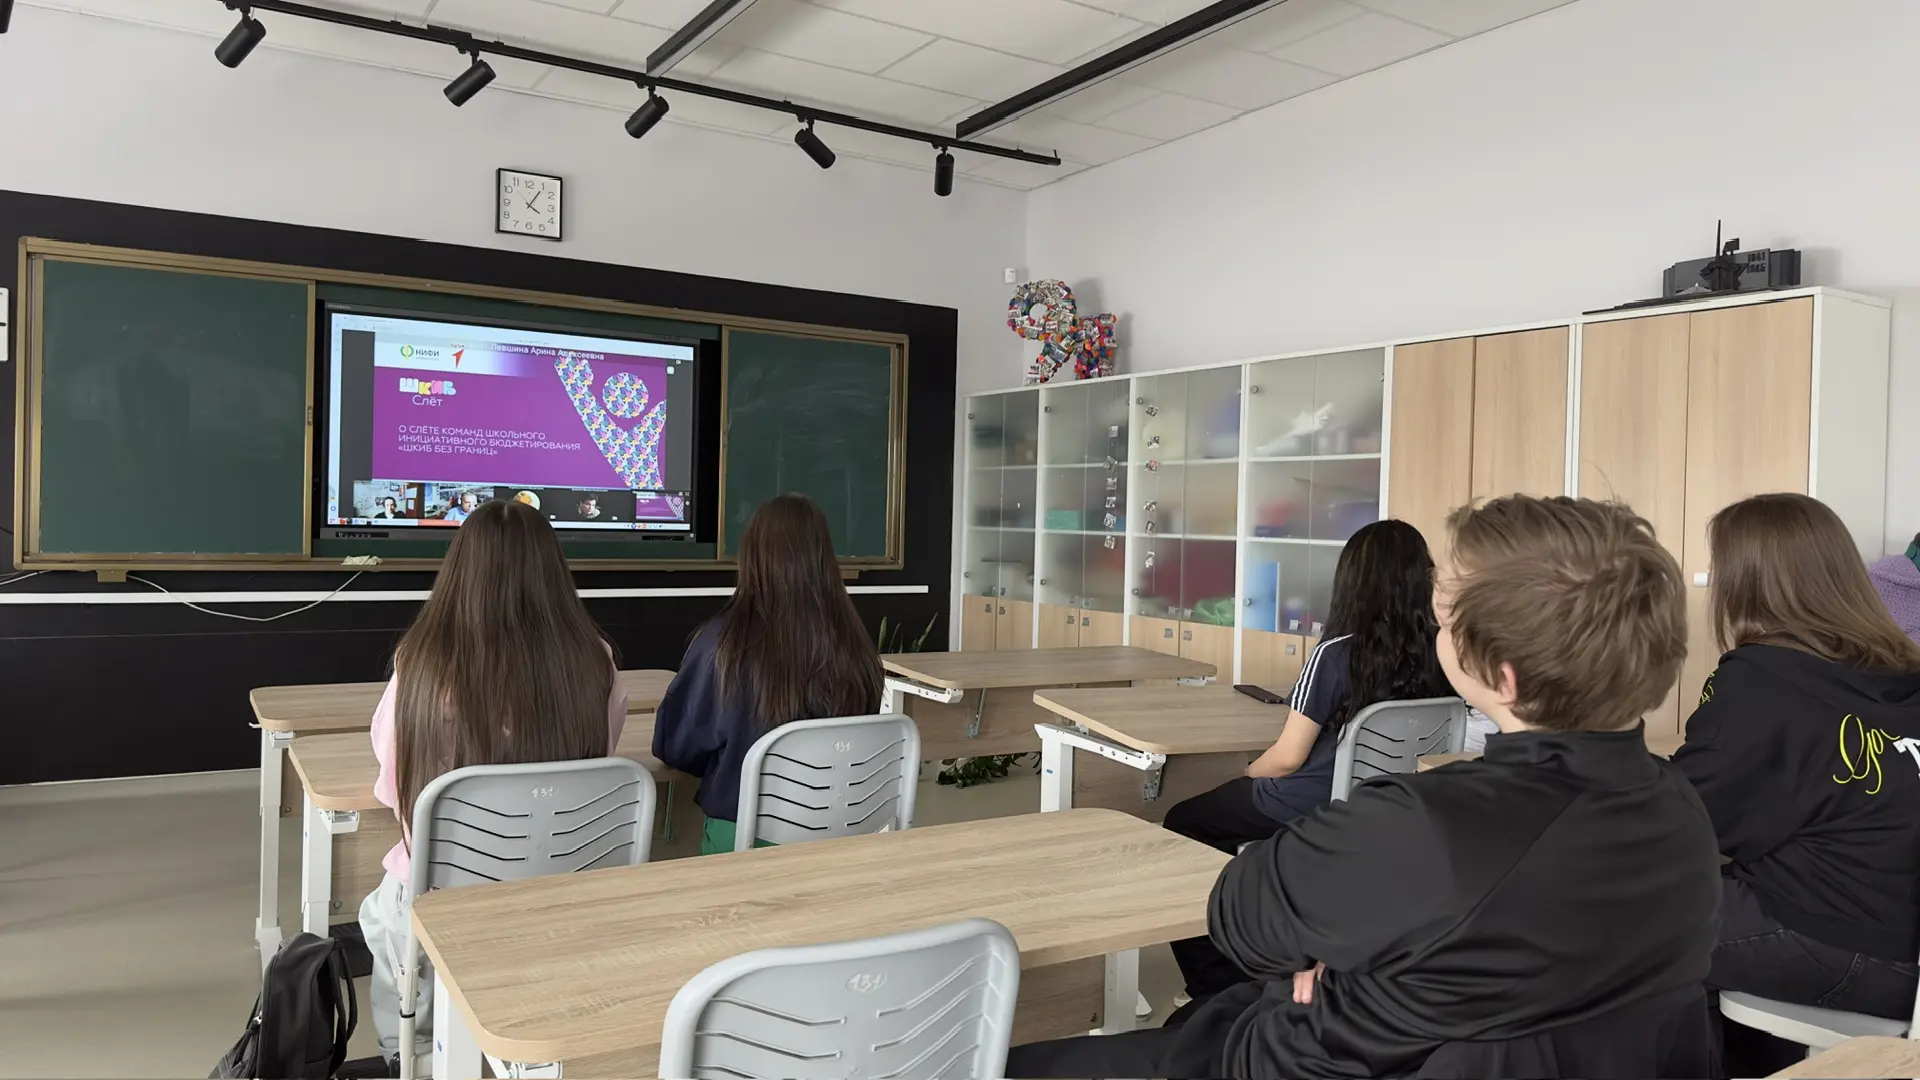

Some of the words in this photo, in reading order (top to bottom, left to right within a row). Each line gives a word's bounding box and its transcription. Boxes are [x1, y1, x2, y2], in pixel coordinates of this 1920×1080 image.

[512, 176, 520, 187] 11
[524, 180, 535, 190] 12
[503, 184, 514, 194] 10
[547, 191, 555, 200] 2
[503, 198, 511, 207] 9
[547, 204, 555, 213] 3
[503, 211, 511, 220] 8
[512, 219, 520, 228] 7
[525, 221, 533, 230] 6
[547, 217, 555, 225] 4
[538, 223, 546, 232] 5
[415, 348, 440, 357] НИФИ
[530, 346, 556, 356] Арина
[412, 394, 443, 407] Слёт
[398, 424, 407, 433] О
[408, 424, 440, 435] СЛЁТЕ
[441, 427, 484, 438] КОМАНД
[485, 430, 546, 440] ШКОЛЬНОГО
[398, 435, 488, 446] ИНИЦИАТИВНОГО
[489, 439, 581, 450] БЮДЖЕТИРОВАНИЯ
[398, 444, 433, 453] «ШКИБ
[434, 445, 452, 453] БЕЗ
[454, 446, 498, 456] ГРАНИЦ»
